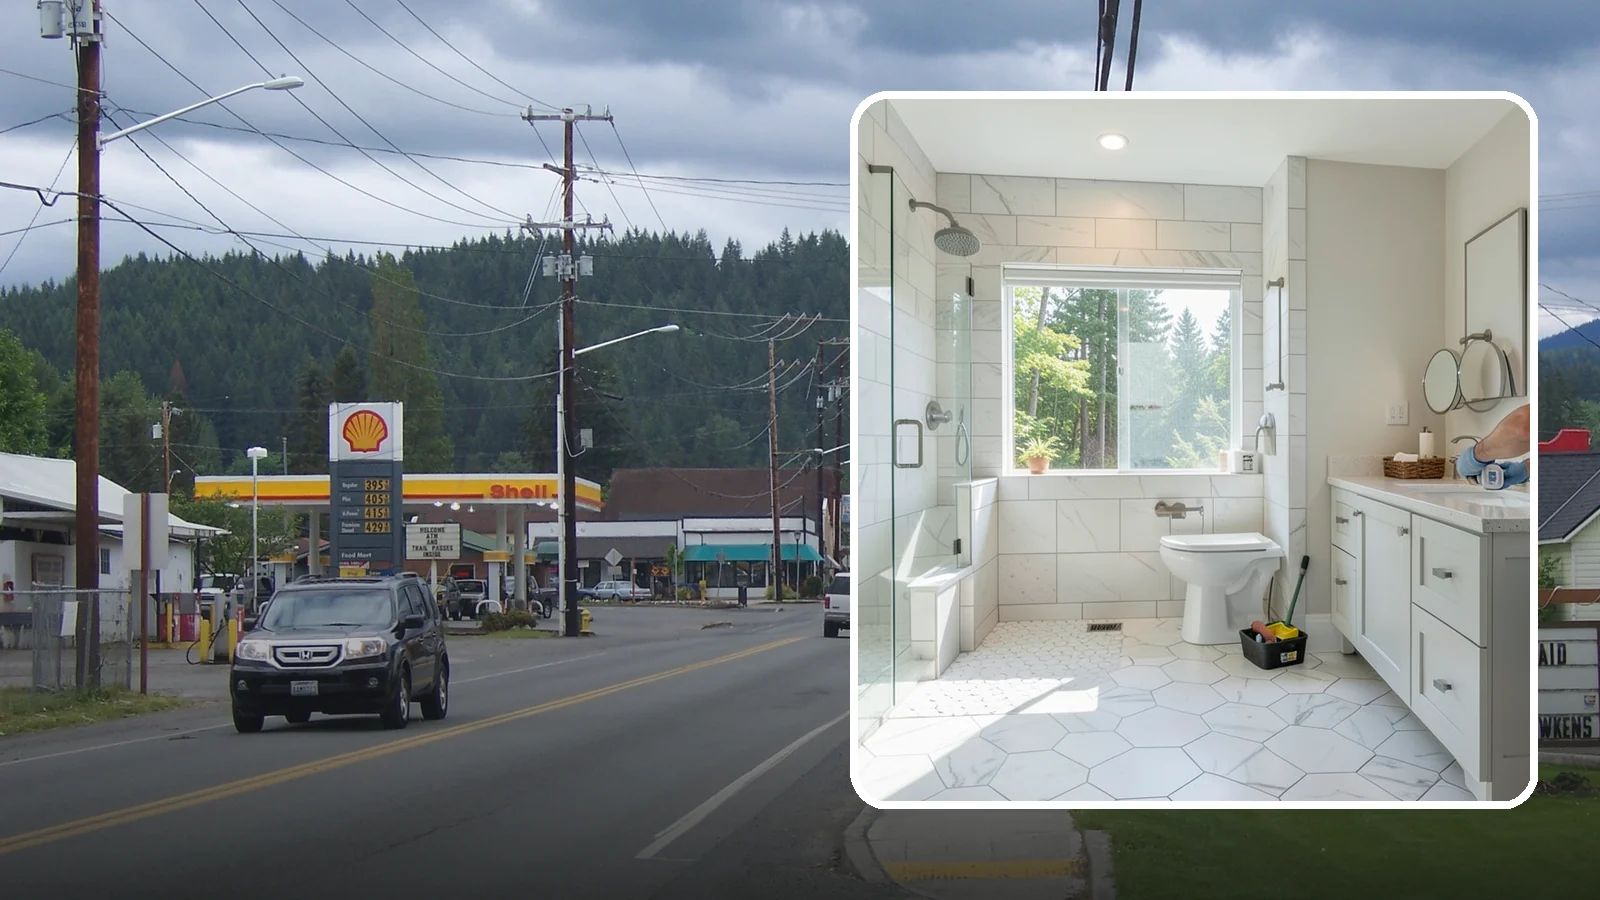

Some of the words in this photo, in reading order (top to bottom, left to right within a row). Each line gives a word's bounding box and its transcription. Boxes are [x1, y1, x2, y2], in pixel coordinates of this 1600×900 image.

[366, 480, 383, 490] 395
[490, 485, 547, 498] Shell
[366, 494, 383, 504] 405
[366, 508, 383, 518] 415
[366, 522, 383, 533] 429
